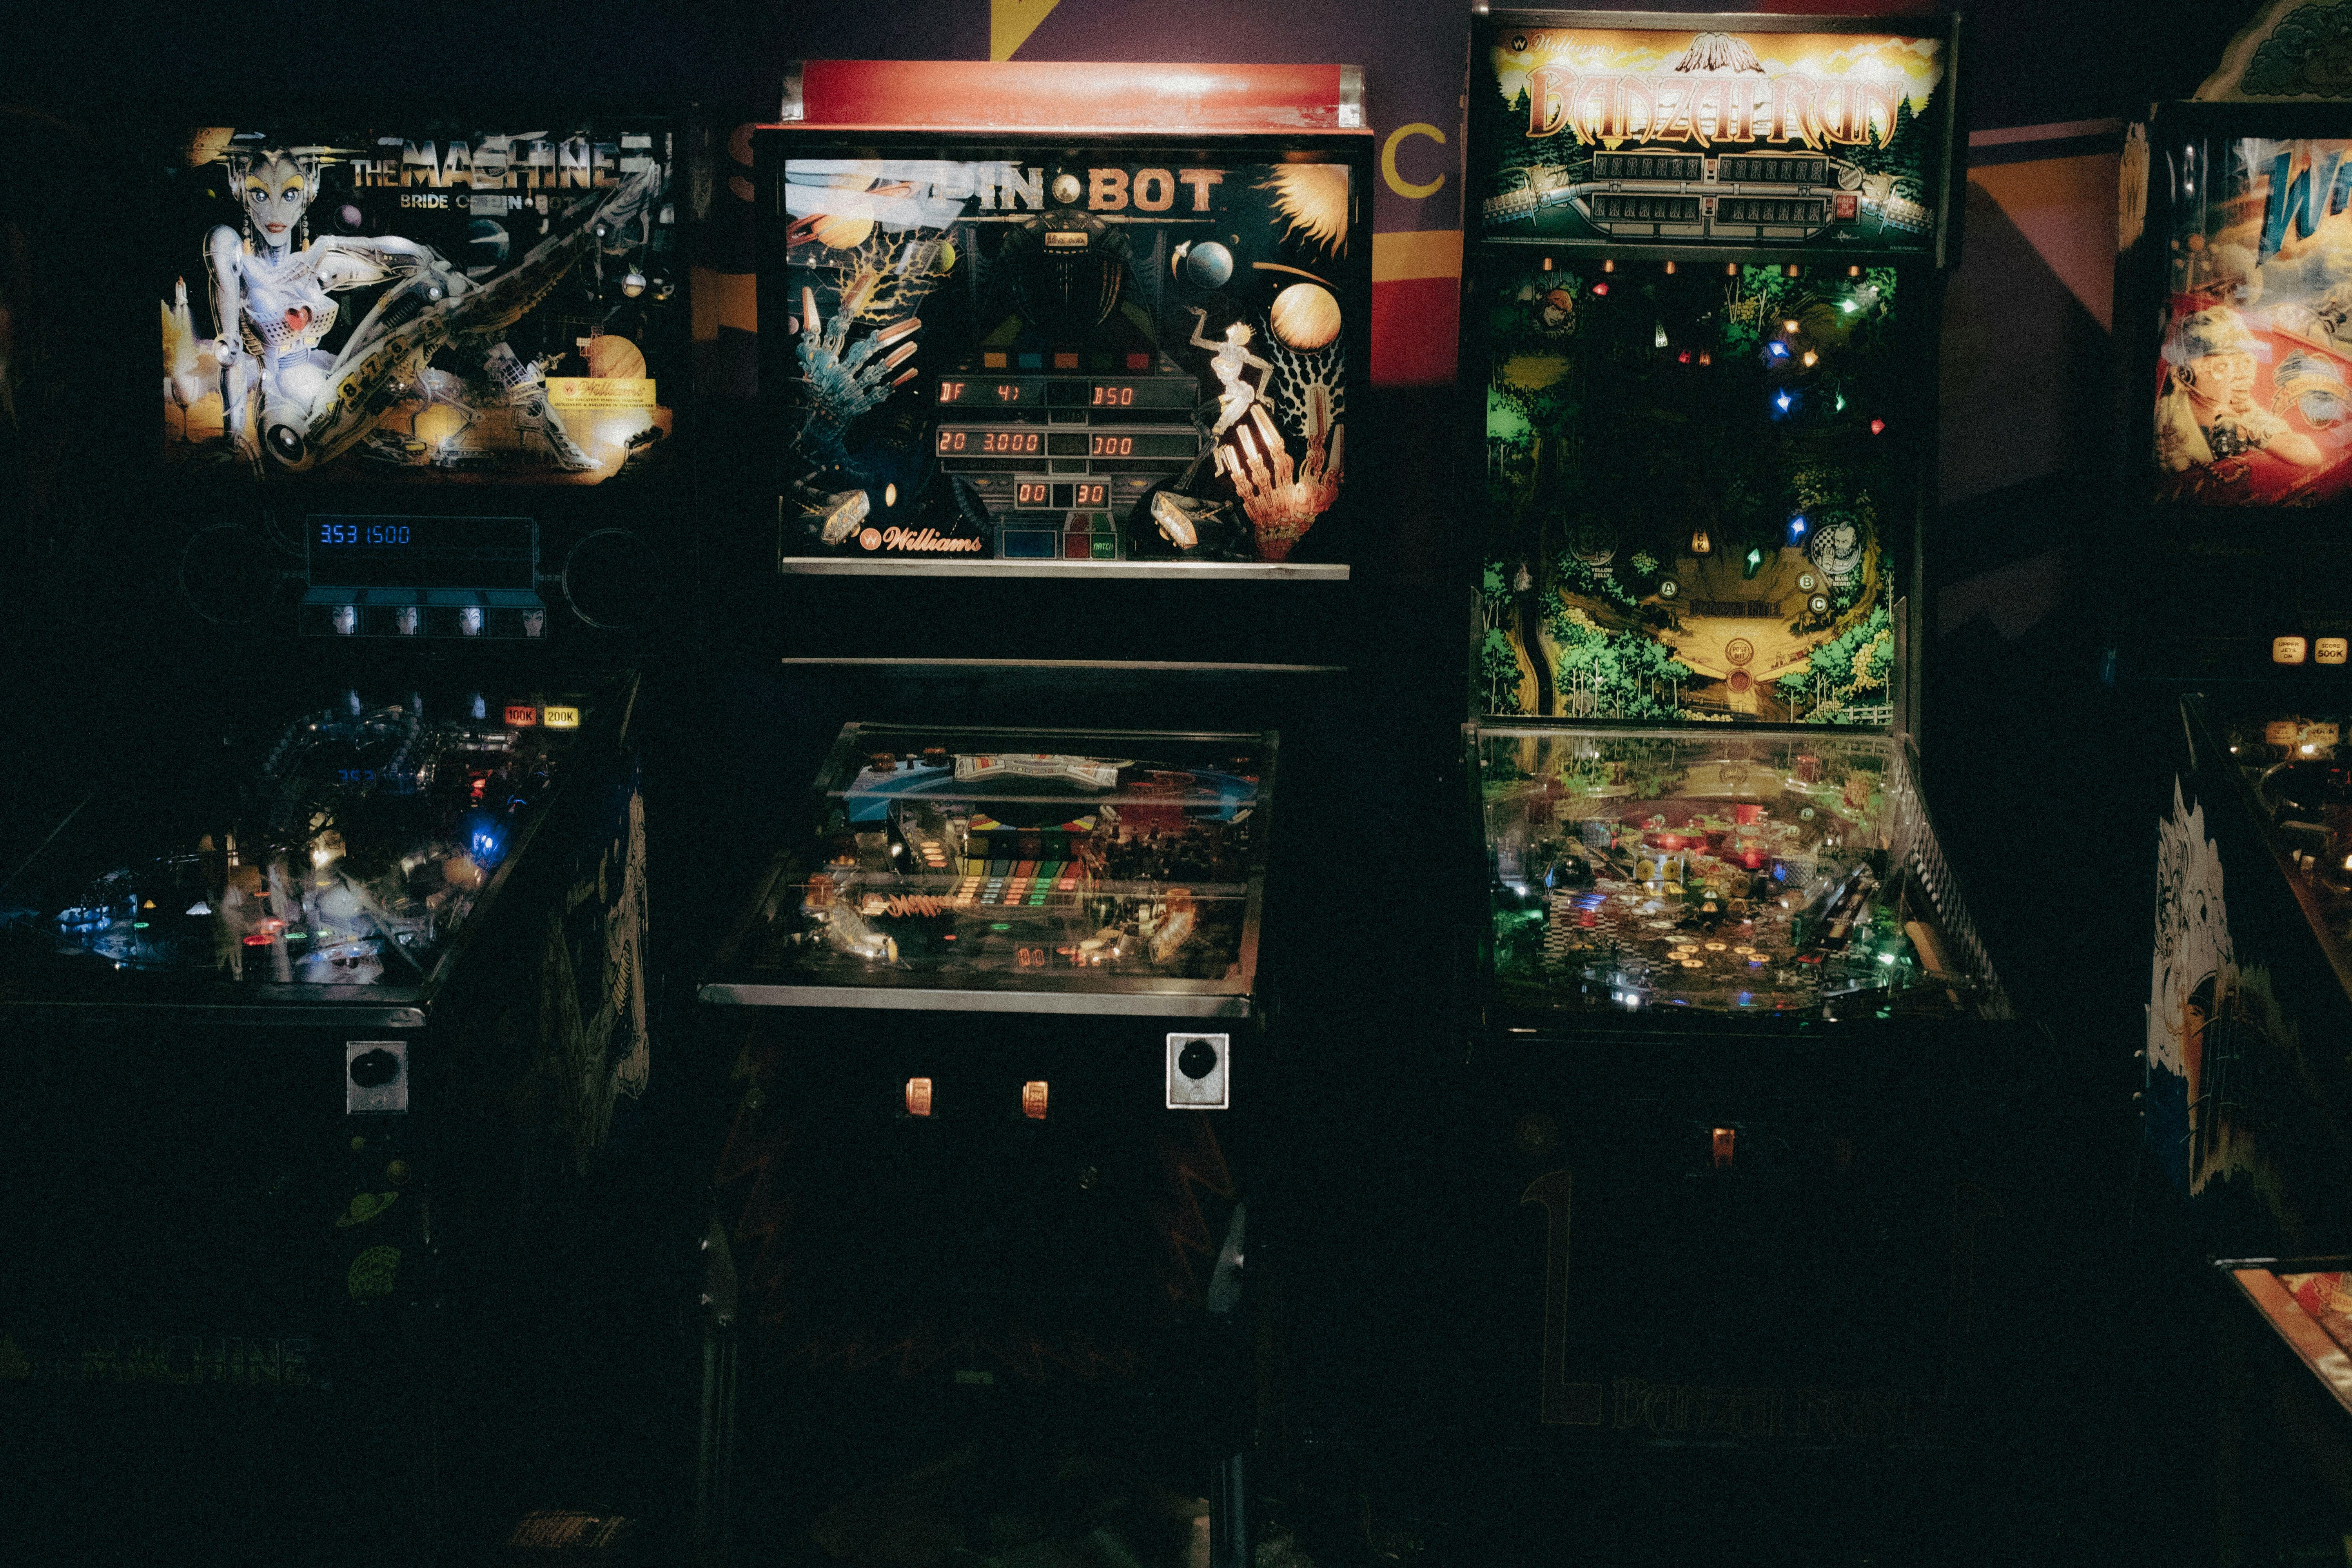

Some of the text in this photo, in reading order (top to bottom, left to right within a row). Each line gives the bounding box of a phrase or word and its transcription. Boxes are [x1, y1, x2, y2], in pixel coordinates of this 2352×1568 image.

[1531, 33, 1613, 54] Williams
[1526, 64, 1902, 150] BANZAI RUN
[350, 159, 398, 187] THE
[1088, 168, 1223, 212] BOT
[400, 194, 448, 209] BRIDE
[1019, 484, 1104, 503] 00 30
[882, 525, 982, 552] Williams
[1664, 583, 1673, 593] A
[509, 710, 532, 721] 100K
[548, 711, 573, 722] 200K
